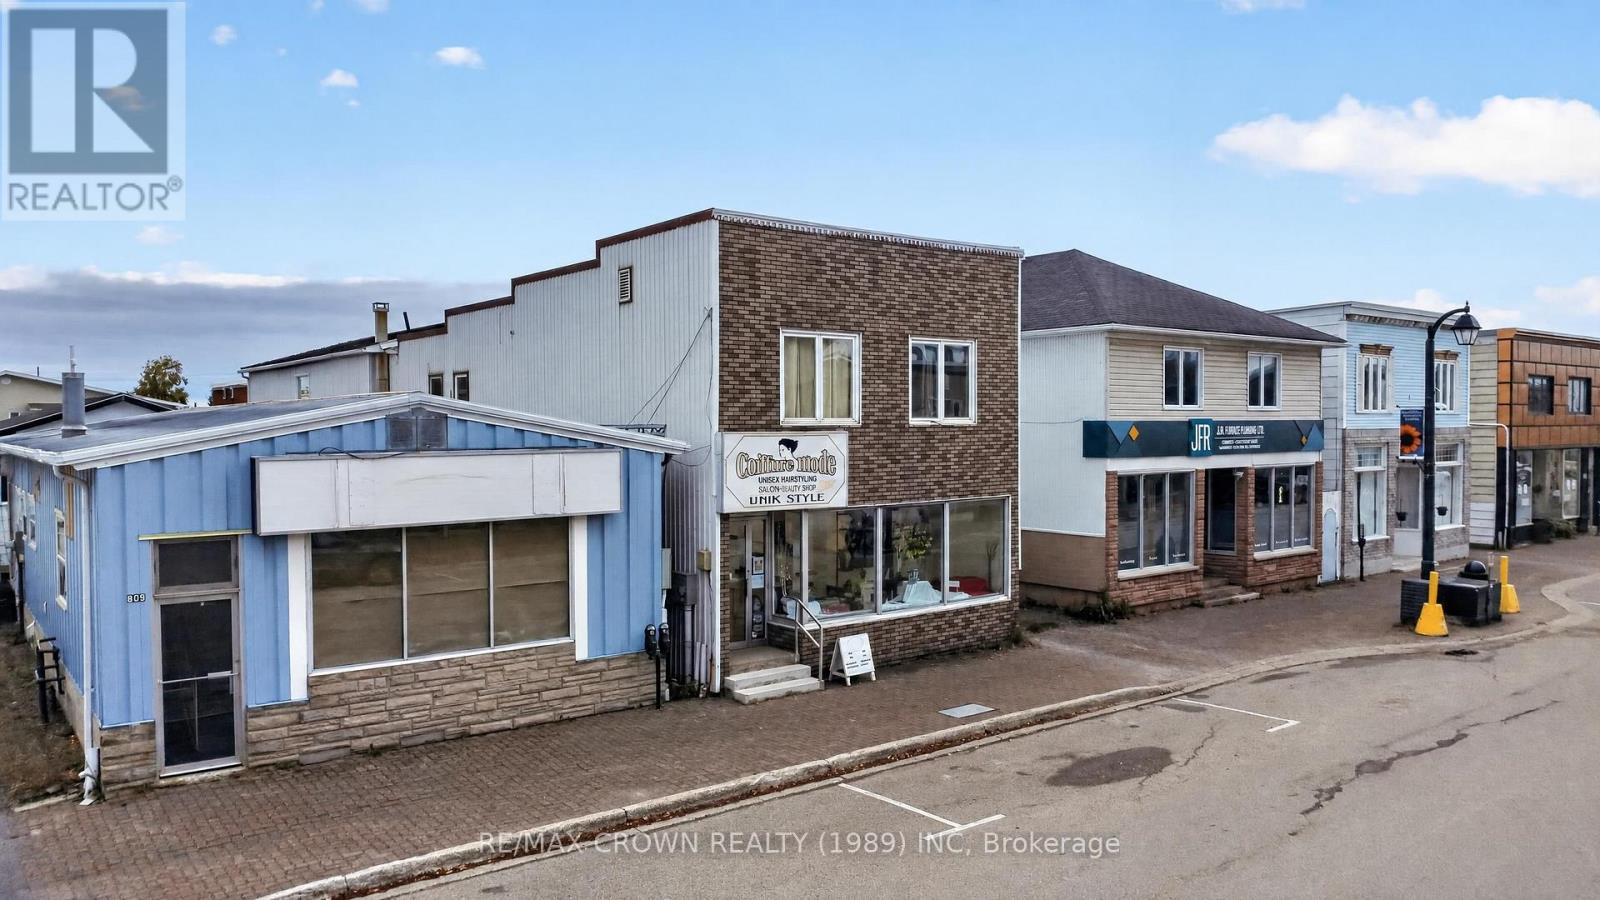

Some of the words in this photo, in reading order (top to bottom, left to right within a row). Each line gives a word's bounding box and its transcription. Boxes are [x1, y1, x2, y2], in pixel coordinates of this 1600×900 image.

[1191, 424, 1211, 451] JFR
[736, 451, 795, 479] Coiffure
[797, 449, 837, 476] mode
[758, 476, 780, 484] UNISEX
[781, 475, 817, 483] HAIRSTYLING
[802, 484, 817, 492] SHOP
[749, 495, 781, 505] UNIK
[786, 493, 825, 503] STYLE
[127, 593, 146, 603] 809
